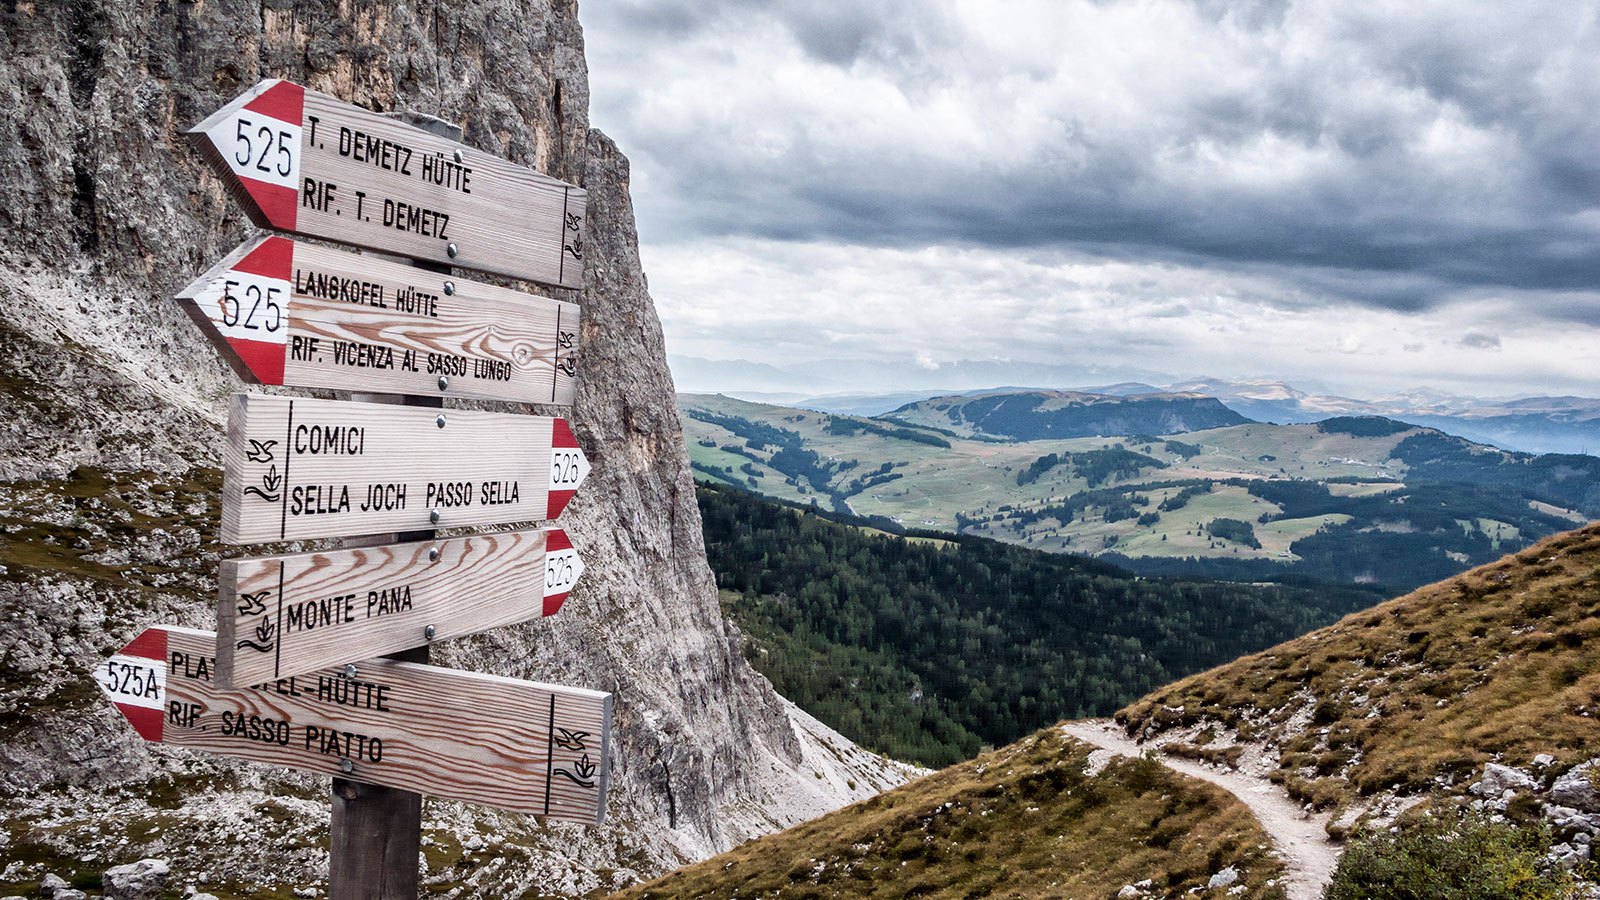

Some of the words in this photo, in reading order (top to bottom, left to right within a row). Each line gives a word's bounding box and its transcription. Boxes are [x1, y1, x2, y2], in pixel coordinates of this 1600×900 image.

[234, 118, 293, 178] 525
[308, 115, 325, 150] T.
[339, 126, 413, 176] DEMETZ
[422, 152, 472, 194] HÜTTE
[302, 177, 341, 216] RIF.
[355, 191, 370, 223] T.
[382, 198, 450, 241] DEMETZ
[223, 280, 281, 333] 525
[295, 269, 387, 309] LANGKOFEL
[395, 286, 439, 318] HÜTTE
[291, 336, 322, 363] RIF.
[333, 341, 394, 370] VICENZA
[401, 349, 419, 373] AL
[426, 353, 467, 377] SASSO
[474, 358, 512, 382] LUNGO
[295, 424, 365, 455] COMICI
[553, 453, 579, 484] 526
[290, 484, 350, 516] SELLA
[360, 483, 408, 512] JOCH
[426, 481, 473, 509] PASSO
[480, 481, 520, 506] SELLA
[547, 556, 573, 588] 525
[286, 594, 356, 634] MONTE
[367, 585, 413, 619] PANA
[107, 661, 159, 701] 525A
[168, 700, 208, 732] RIF.
[220, 710, 290, 747] SASSO
[305, 725, 384, 764] PIATTO
